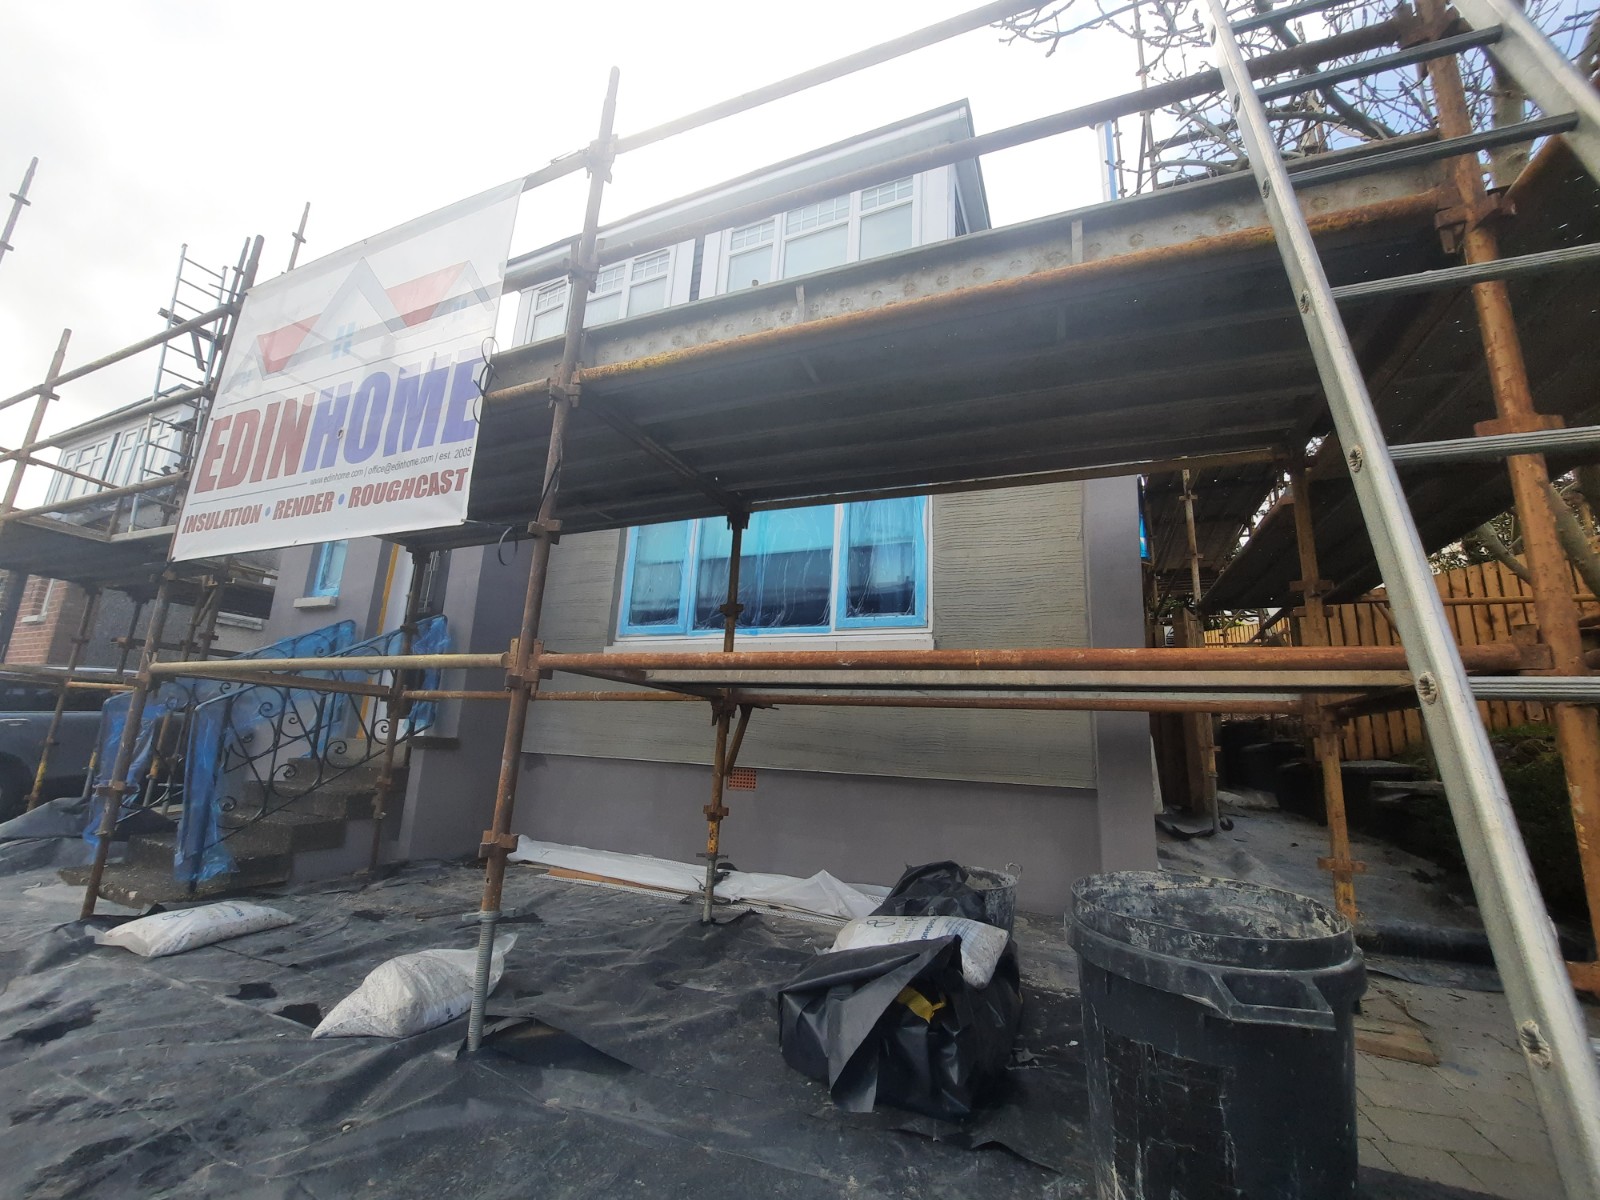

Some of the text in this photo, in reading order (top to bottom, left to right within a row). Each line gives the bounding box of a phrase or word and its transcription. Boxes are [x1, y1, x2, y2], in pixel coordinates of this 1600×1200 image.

[194, 342, 488, 494] EDINHOME
[368, 454, 434, 475] office@edinhome.com
[454, 446, 473, 459] 2005
[182, 468, 469, 534] INSULATION RENDER ROUGHCAST
